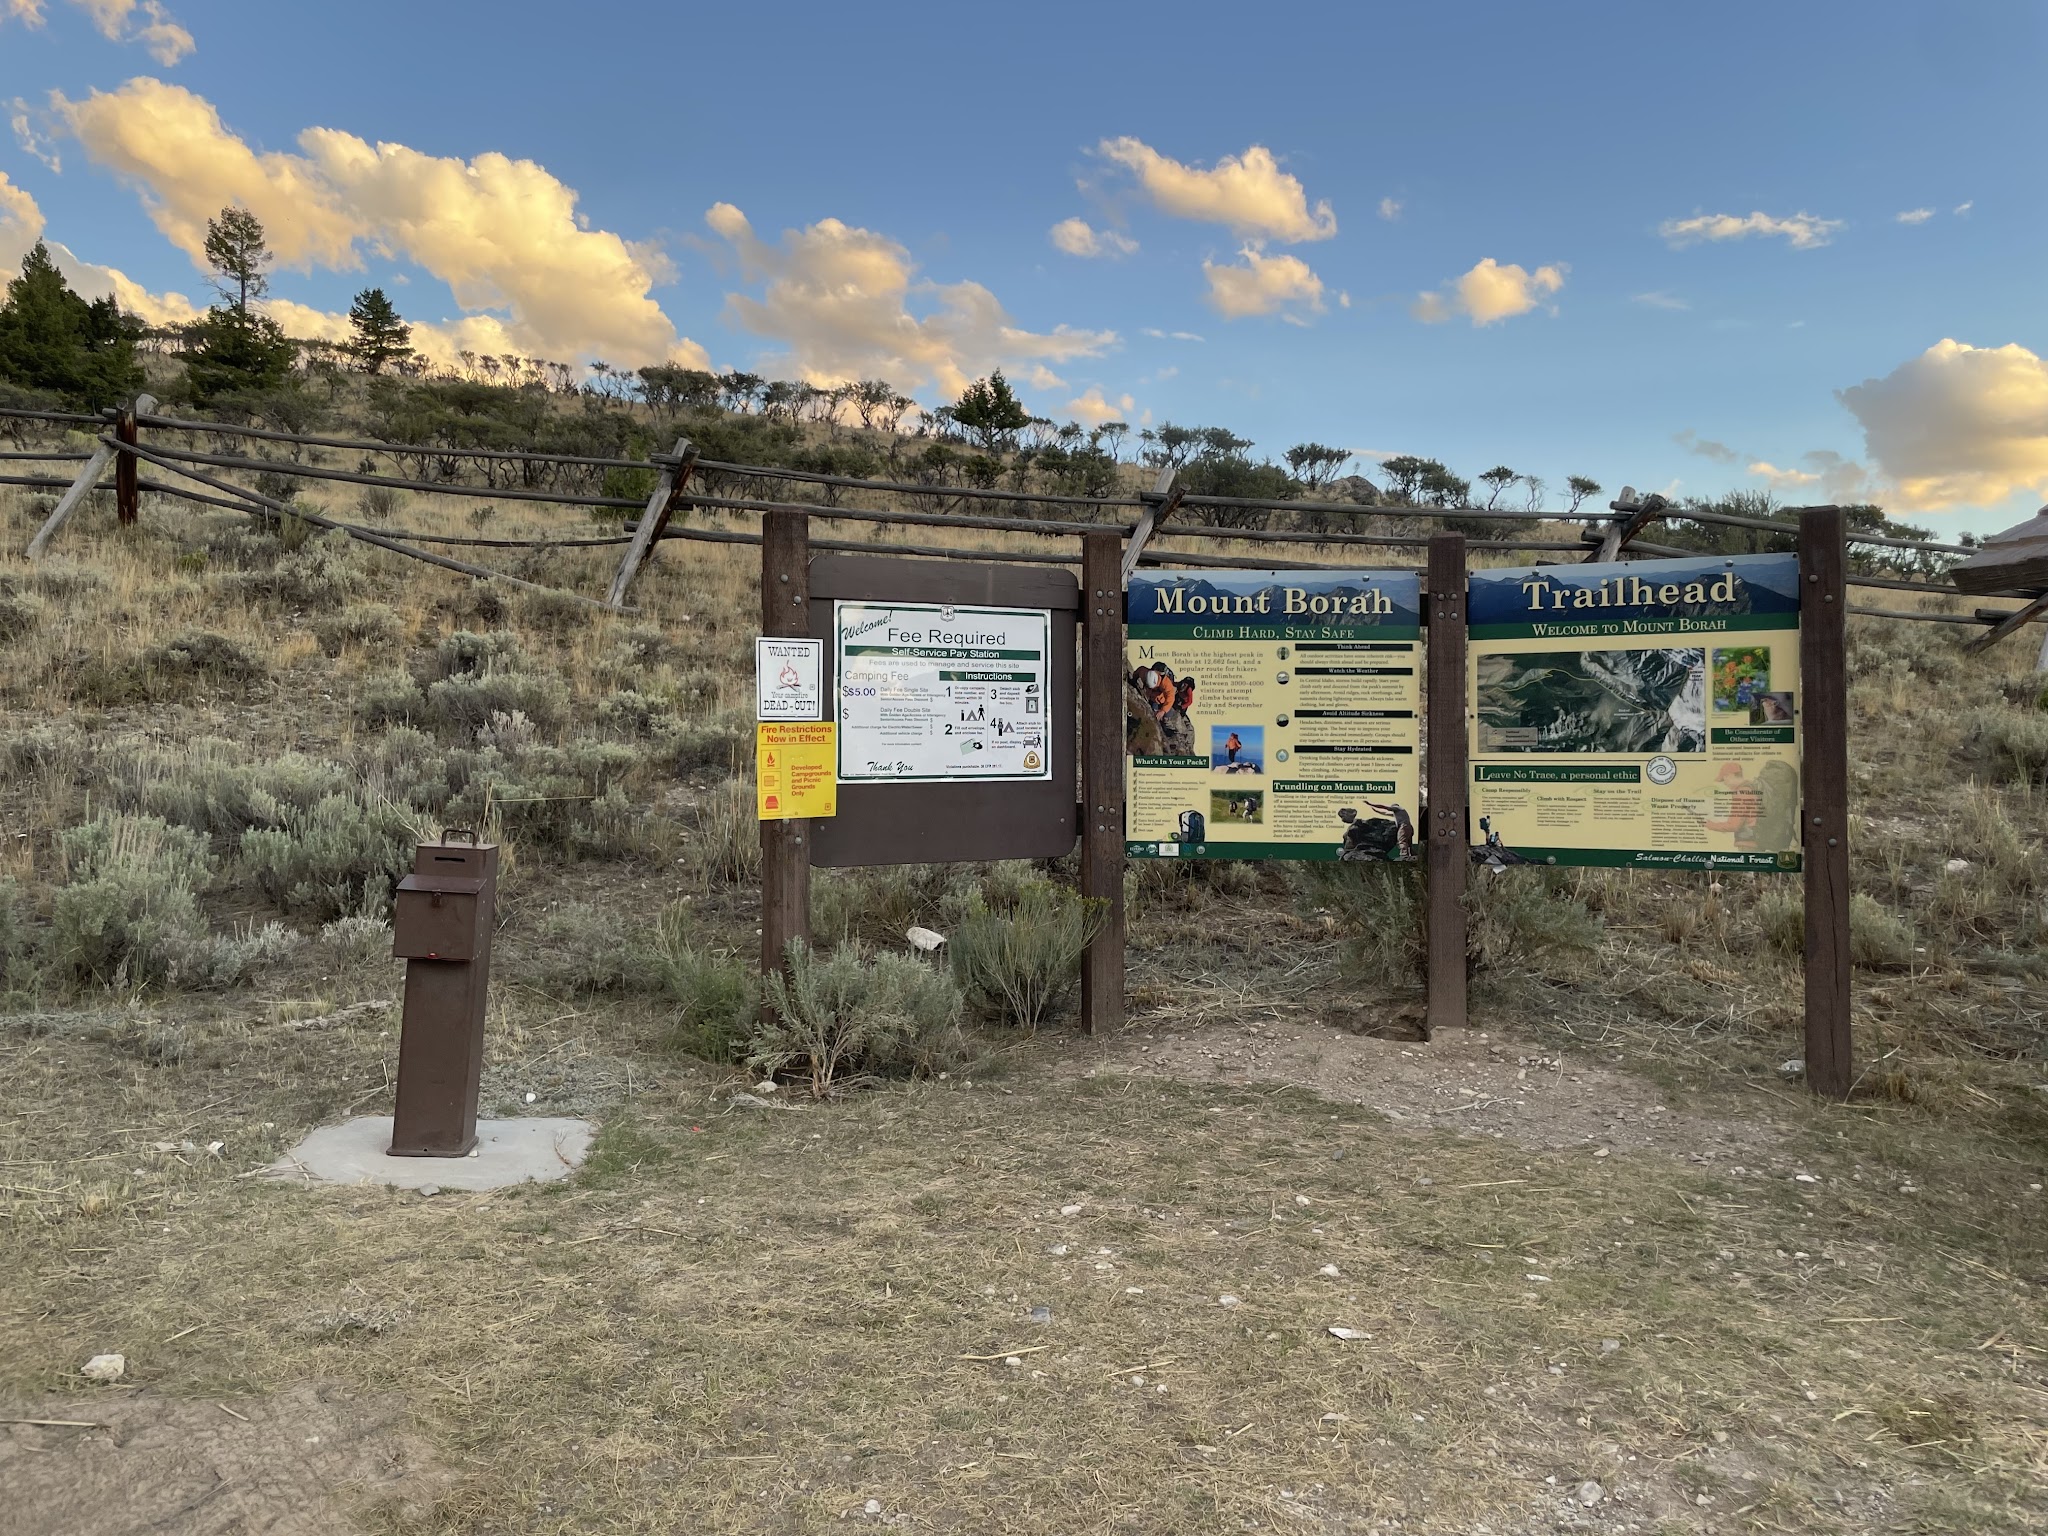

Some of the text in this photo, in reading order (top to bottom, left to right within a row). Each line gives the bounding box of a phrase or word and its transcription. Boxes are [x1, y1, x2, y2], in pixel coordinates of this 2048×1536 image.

[1522, 572, 1736, 611] Trailhead
[1154, 587, 1394, 615] Mount Borah
[842, 610, 893, 640] Welcome!
[1533, 618, 1726, 637] WELCOME TO MOUNT BORAH
[888, 628, 1006, 647] Fee Required
[1193, 626, 1355, 640] CLIMB HARD, STAY SAFE
[768, 647, 810, 658] WANTED
[892, 647, 999, 658] Self-Service Pay Station
[1139, 645, 1169, 659] Mount
[845, 671, 908, 682] Camping Fee
[966, 672, 1012, 680] Instructions
[946, 687, 951, 697] 1
[990, 689, 997, 700] 3
[842, 708, 849, 719] $
[990, 718, 996, 728] 4
[779, 725, 832, 733] Restrictions
[945, 724, 953, 735] 2
[767, 735, 786, 743] Now
[799, 734, 825, 742] Effect
[867, 761, 913, 773] Thank You
[1479, 767, 1511, 780] Leave
[1514, 771, 1527, 779] No
[1529, 771, 1558, 780] Trace,
[1569, 771, 1611, 781] personal
[1613, 771, 1638, 779] ethic
[1274, 782, 1319, 791] Trundling
[1334, 783, 1364, 791] Mount
[1636, 853, 1773, 864] Salmon-Challis National Forest
